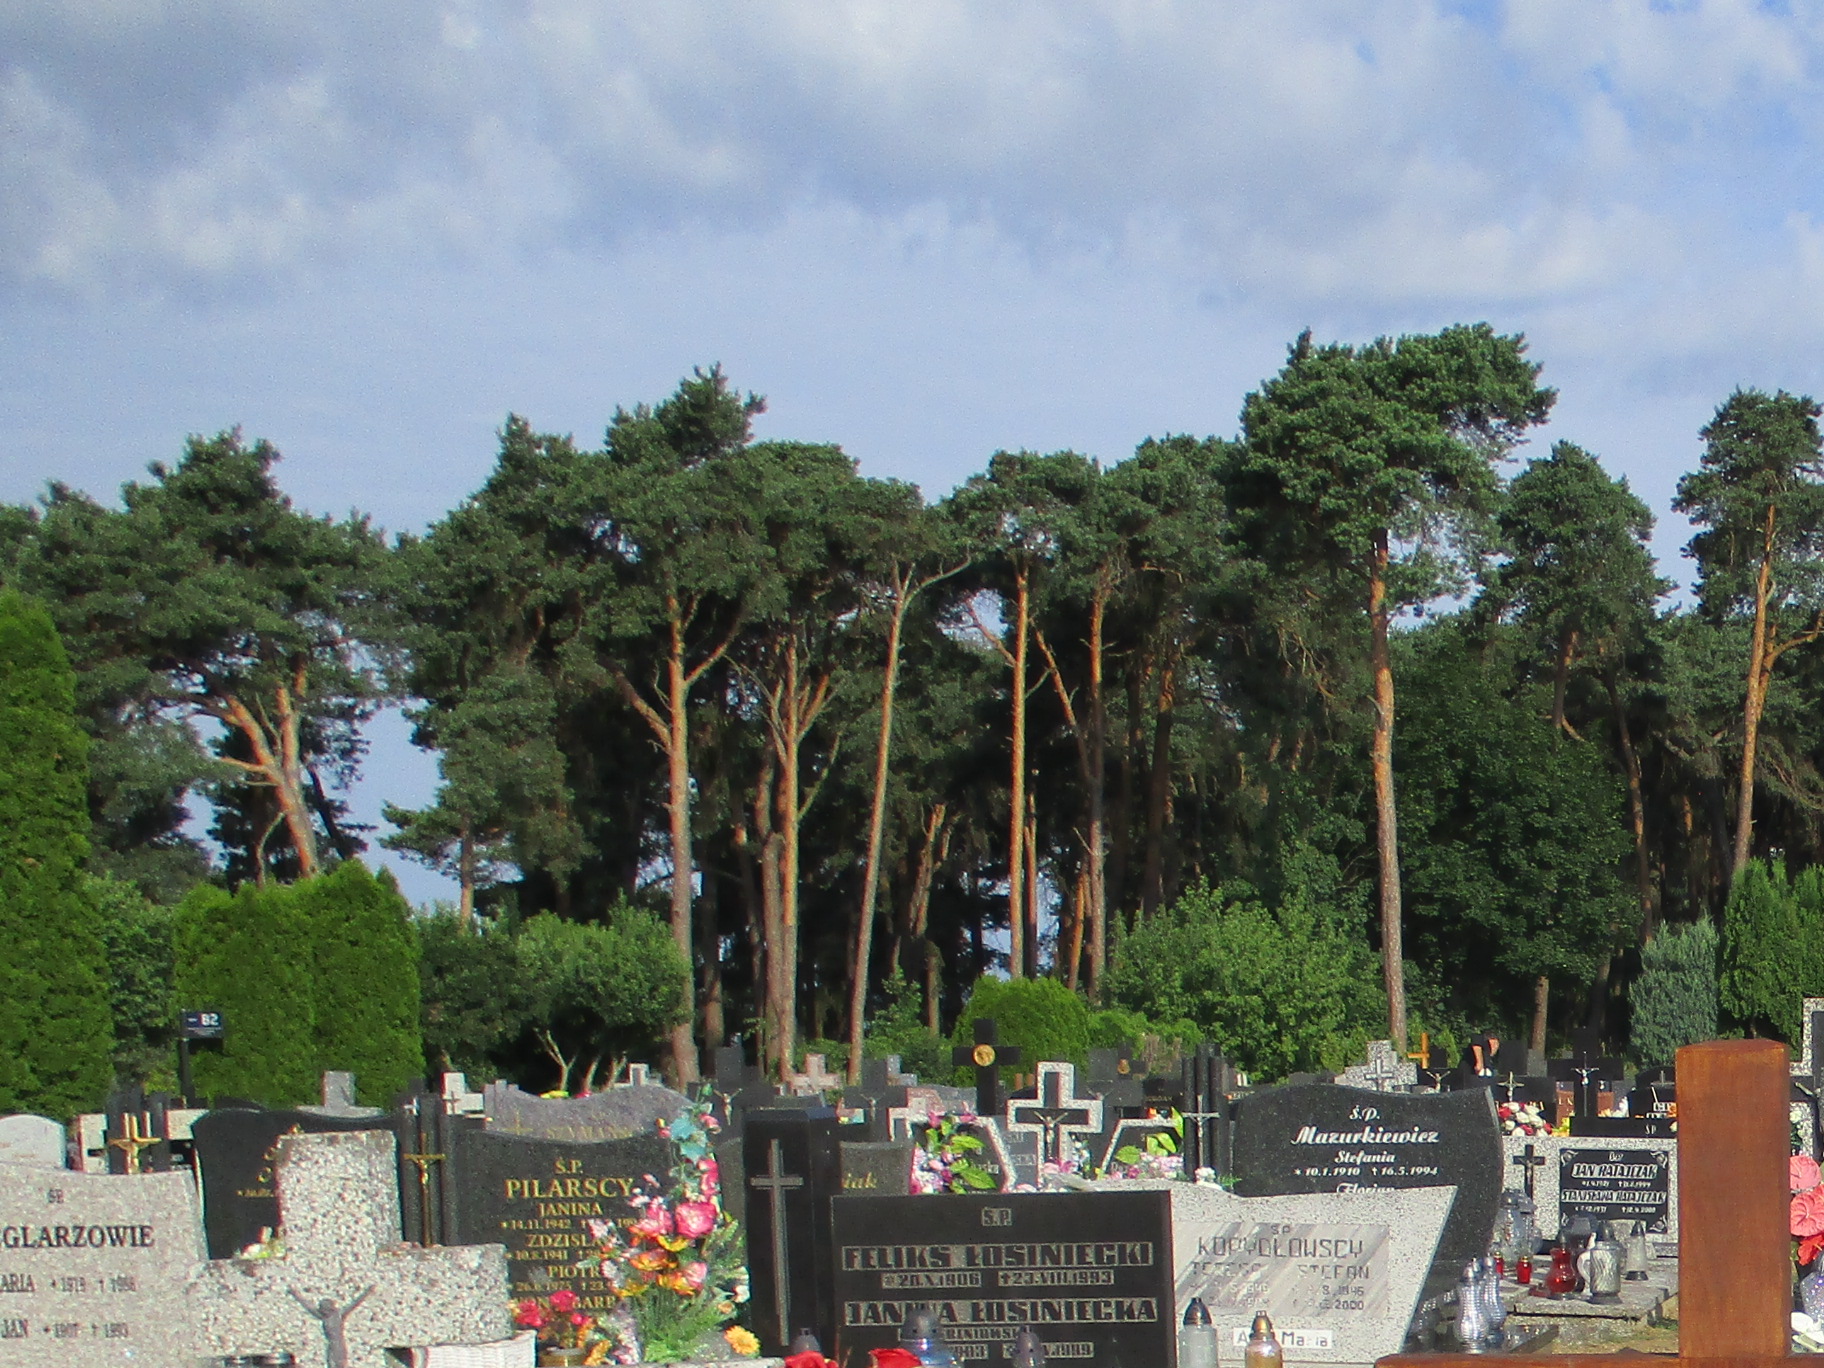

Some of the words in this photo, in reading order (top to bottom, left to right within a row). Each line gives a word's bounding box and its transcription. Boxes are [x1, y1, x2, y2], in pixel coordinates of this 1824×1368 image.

[1290, 1125, 1441, 1145] Mazurkiewicz
[1334, 1150, 1397, 1165] Stefania
[1598, 1163, 1658, 1178] RATAJCZAK
[504, 1178, 635, 1198] PILARSCY
[537, 1202, 603, 1217] JANINA
[0, 1225, 155, 1247] GLARZOWIE
[844, 1246, 951, 1269] FELIKS
[0, 1274, 36, 1292] ARIA
[846, 1302, 958, 1324] JANA
